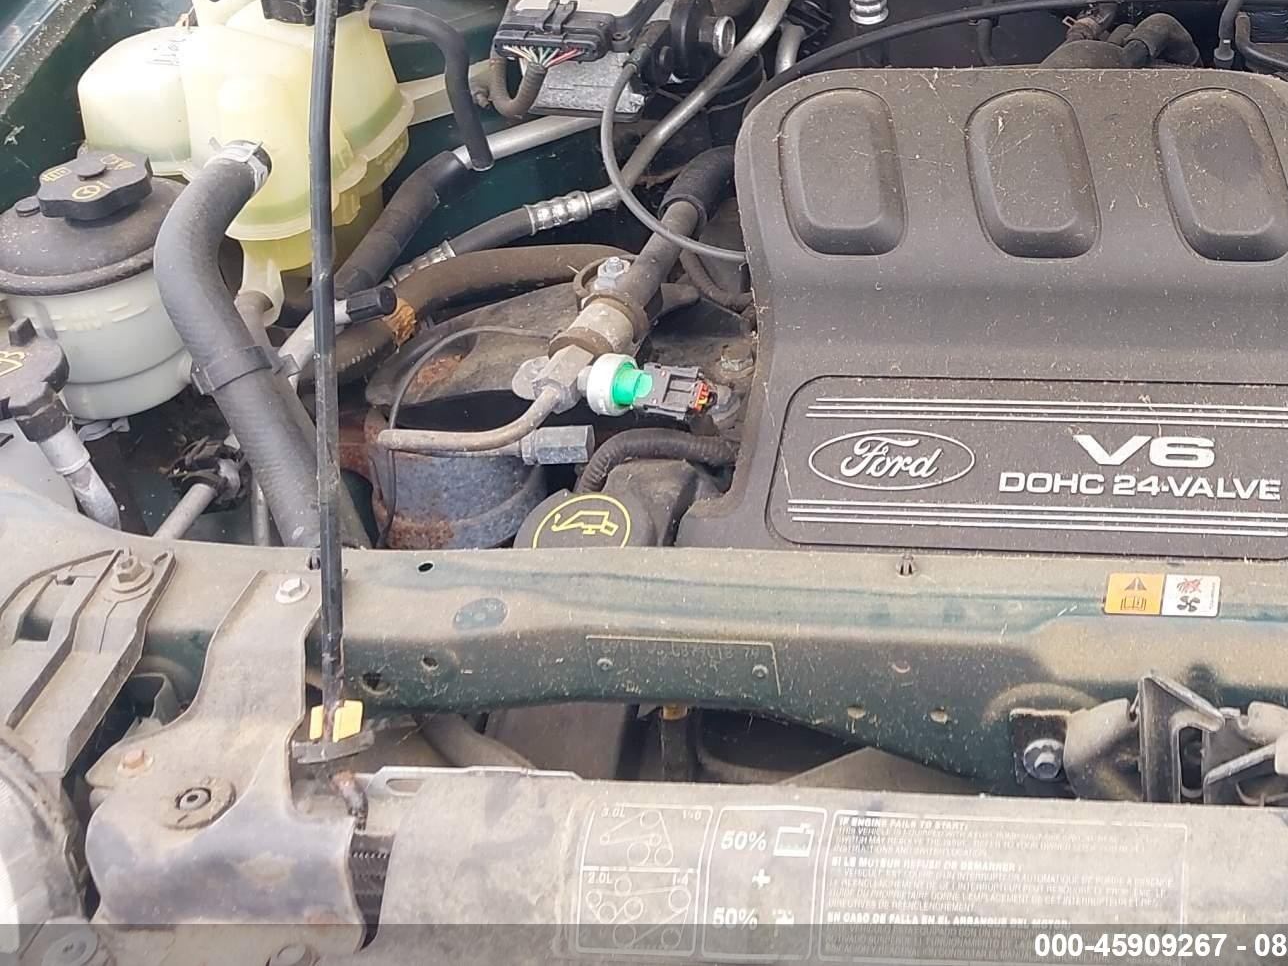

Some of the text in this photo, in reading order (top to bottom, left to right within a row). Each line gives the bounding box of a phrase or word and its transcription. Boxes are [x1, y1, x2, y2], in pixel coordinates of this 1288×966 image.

[841, 435, 941, 481] Ford
[1074, 435, 1215, 468] V6
[999, 472, 1104, 495] DOHC
[720, 830, 767, 851] 50%
[712, 907, 758, 930] 50%
